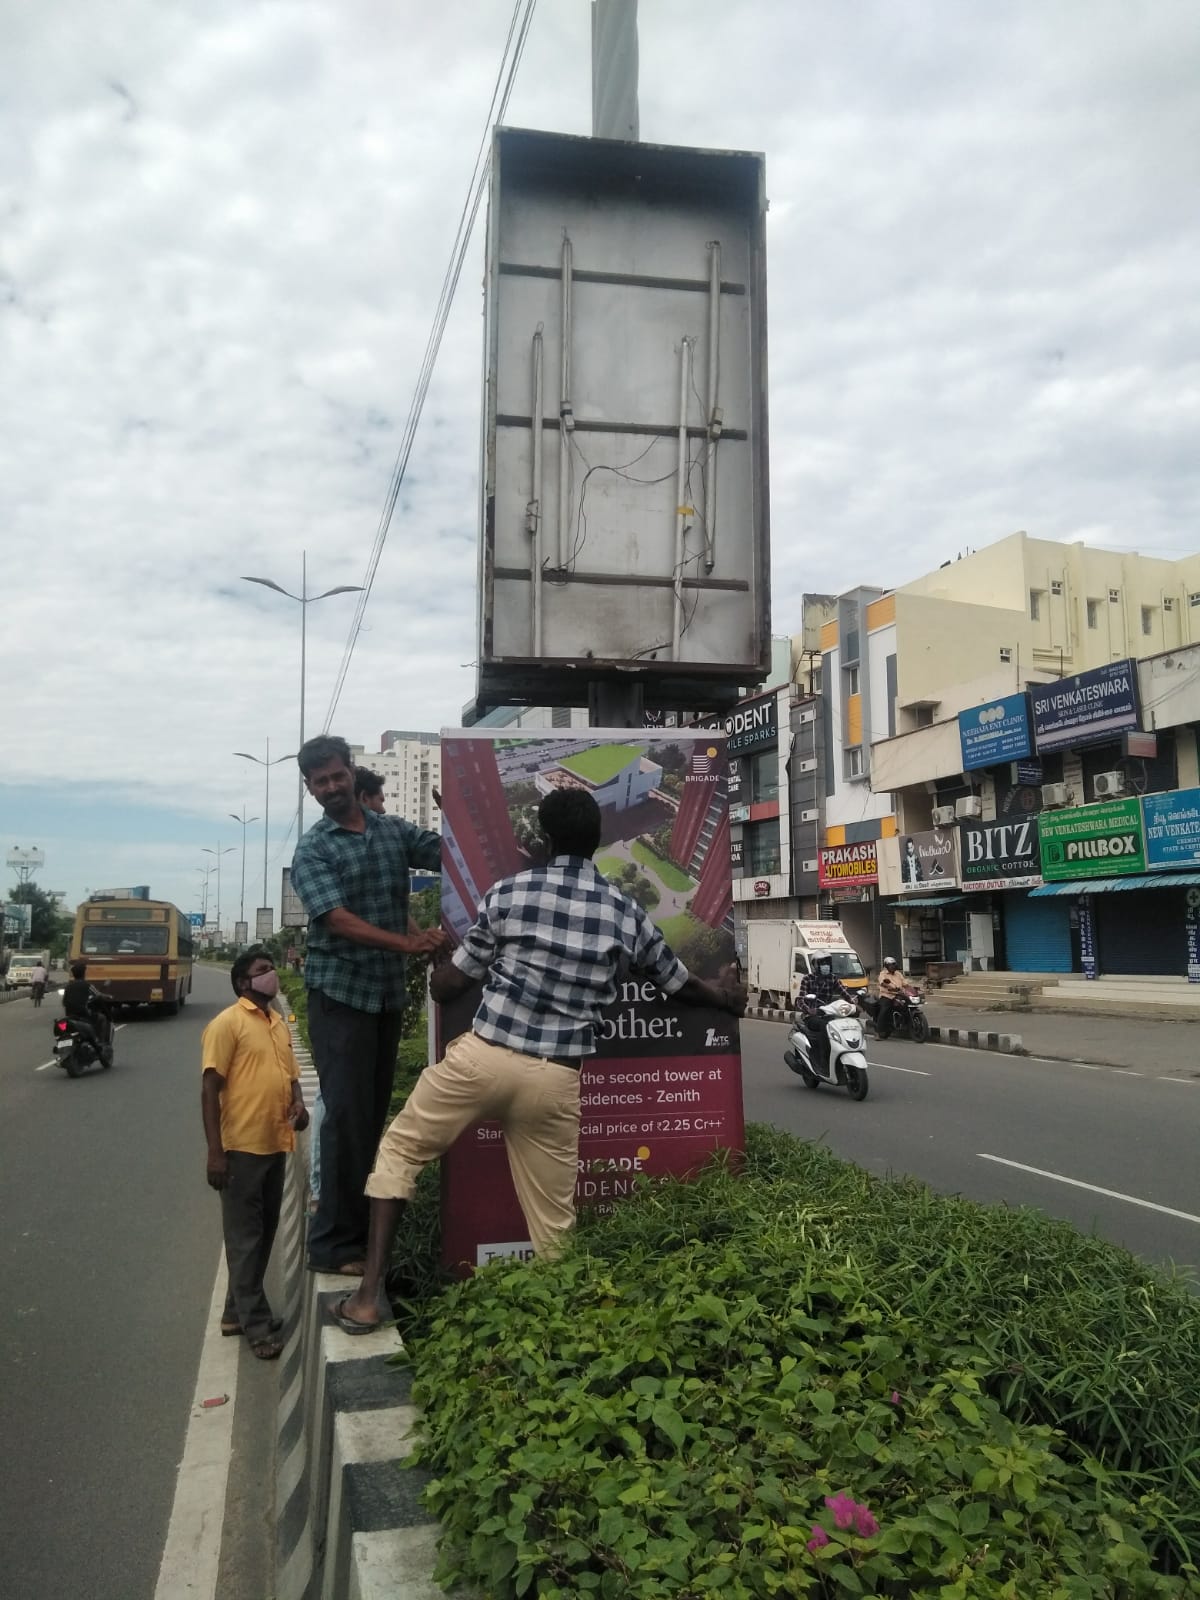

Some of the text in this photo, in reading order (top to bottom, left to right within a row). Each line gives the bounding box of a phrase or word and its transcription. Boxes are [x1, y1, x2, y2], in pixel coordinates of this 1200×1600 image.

[1035, 677, 1130, 715] SRI VENKATESWARA
[989, 720, 1002, 731] ENT
[1003, 714, 1024, 727] CLINIC
[744, 726, 776, 746] SPARKS
[685, 774, 719, 783] BRIGADE
[1042, 828, 1054, 838] NEW
[1055, 818, 1108, 836] VENKATESHWARA
[1109, 814, 1139, 829] MEDICAL
[1147, 825, 1164, 840] NEW
[1165, 821, 1200, 837] VENKATE
[967, 822, 1032, 862] BITZ
[1067, 835, 1136, 860] PILLBOX
[822, 844, 876, 865] PRAKASH
[967, 864, 999, 874] ORGANIC
[1001, 860, 1035, 870] COTTON
[986, 880, 1006, 889] OUTLET
[621, 980, 668, 1002] ne
[598, 1008, 683, 1040] other.
[582, 1068, 722, 1085] the second tower at
[581, 1092, 643, 1105] sidences
[656, 1089, 700, 1103] Zenith
[477, 1127, 504, 1140] Star
[578, 1123, 602, 1135] cial
[607, 1121, 638, 1136] price
[641, 1120, 654, 1132] of
[657, 1118, 691, 1132] ₹2.25
